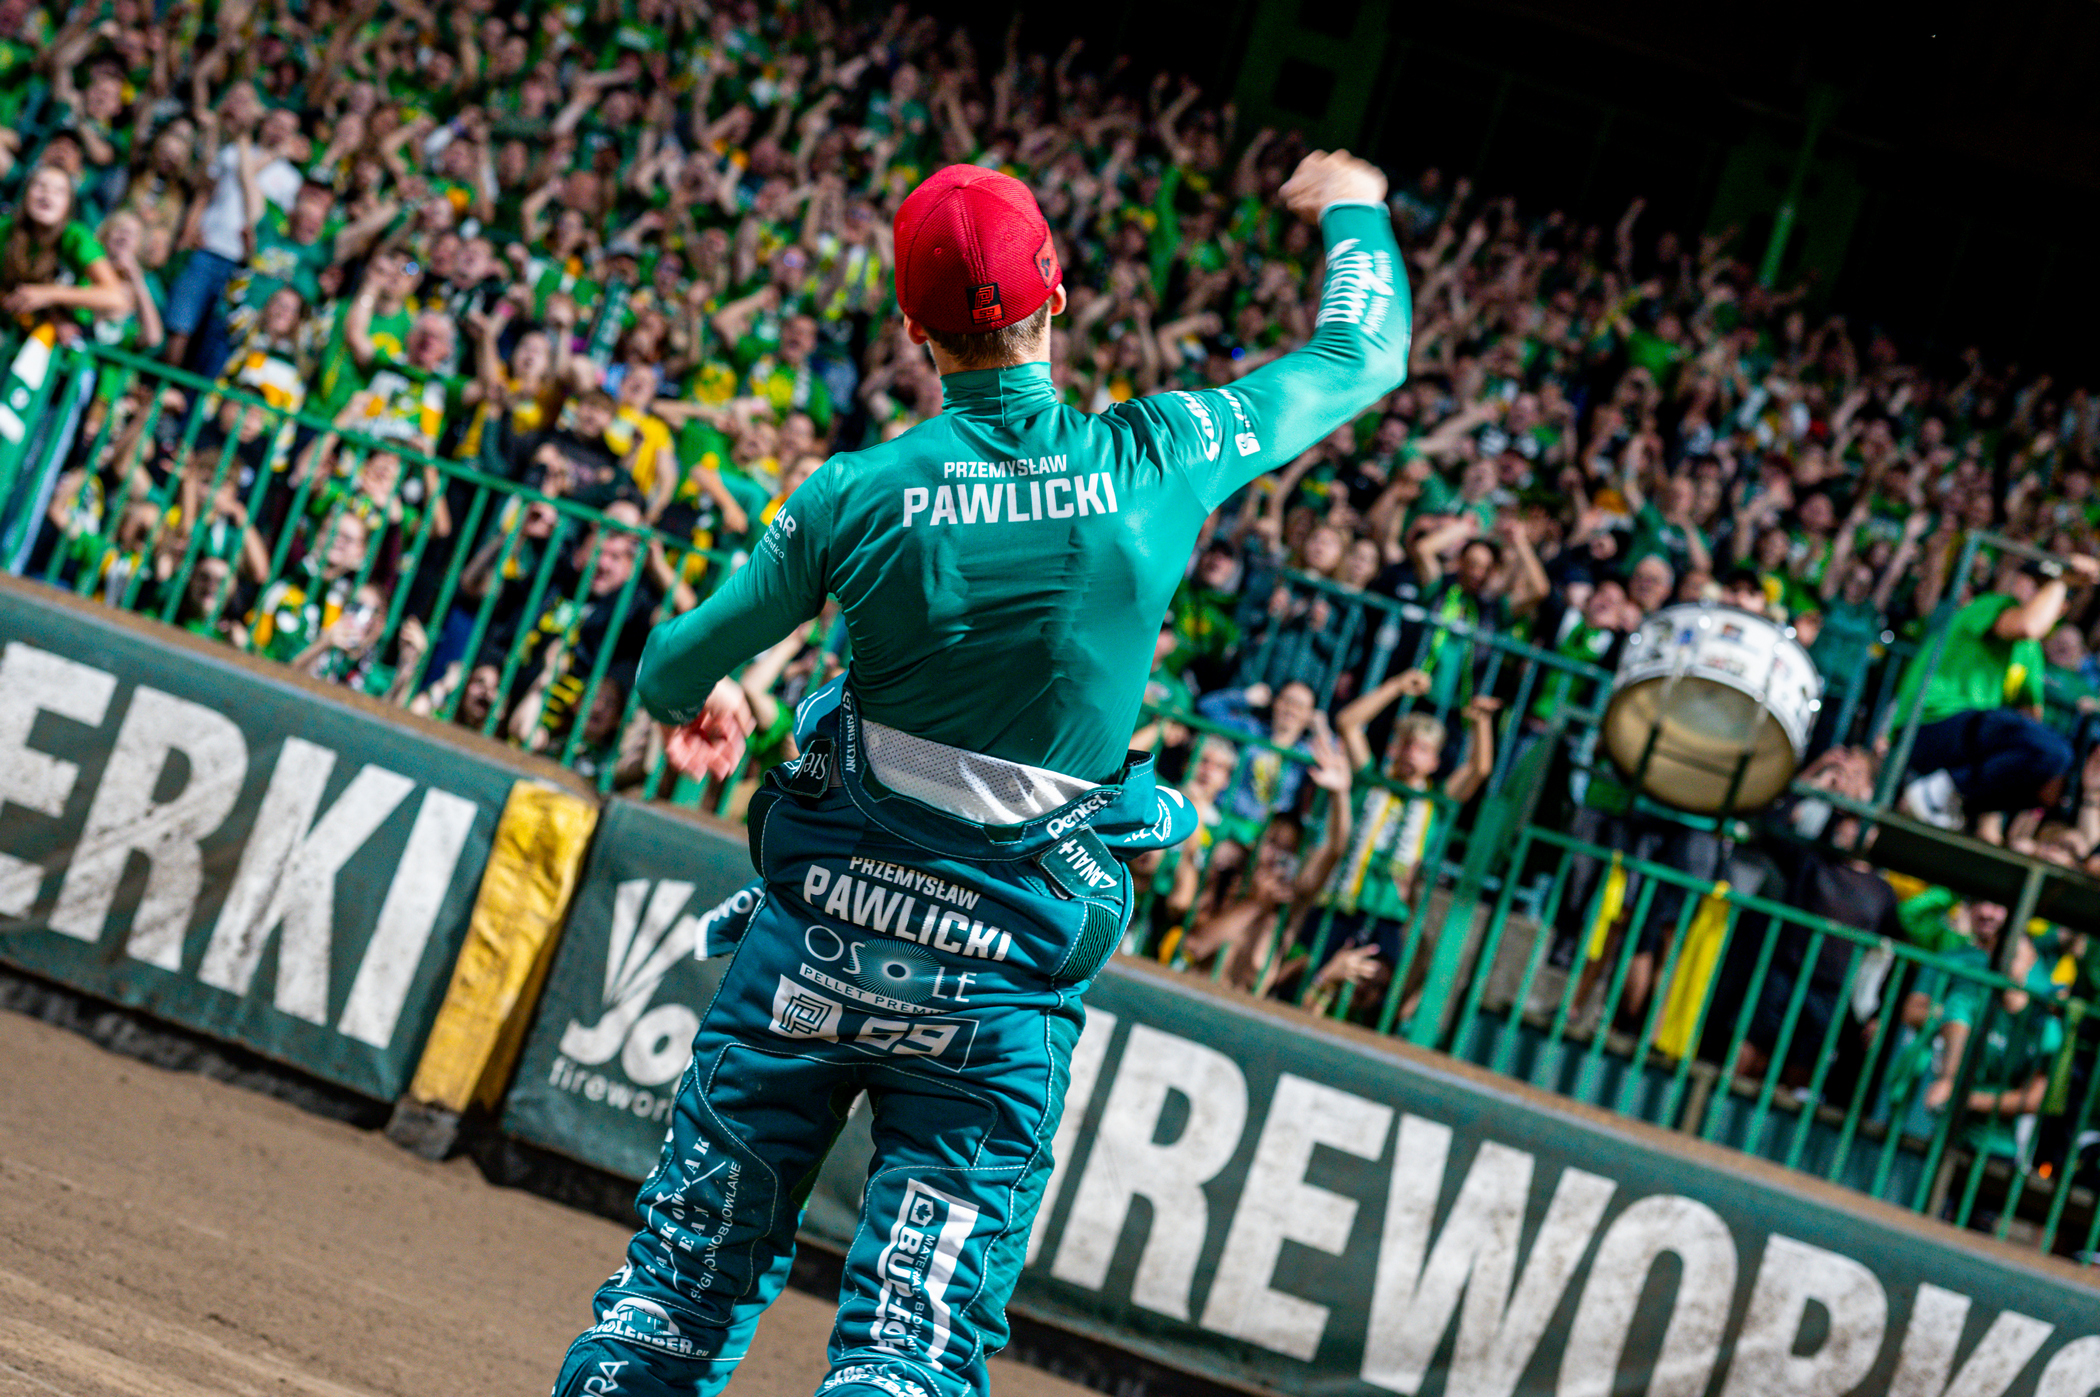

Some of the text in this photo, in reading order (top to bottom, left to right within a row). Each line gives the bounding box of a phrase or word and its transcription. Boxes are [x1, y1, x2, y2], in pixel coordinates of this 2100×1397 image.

[944, 454, 1067, 479] PRZEMYSŁAW
[902, 472, 1118, 527] PAWLICKI
[849, 856, 980, 910] PRZEMYSŁAW
[1058, 838, 1118, 889] CANAL+
[803, 864, 1012, 962] PAWLICKI
[804, 967, 866, 1000] PELLET
[854, 1016, 960, 1057] 59
